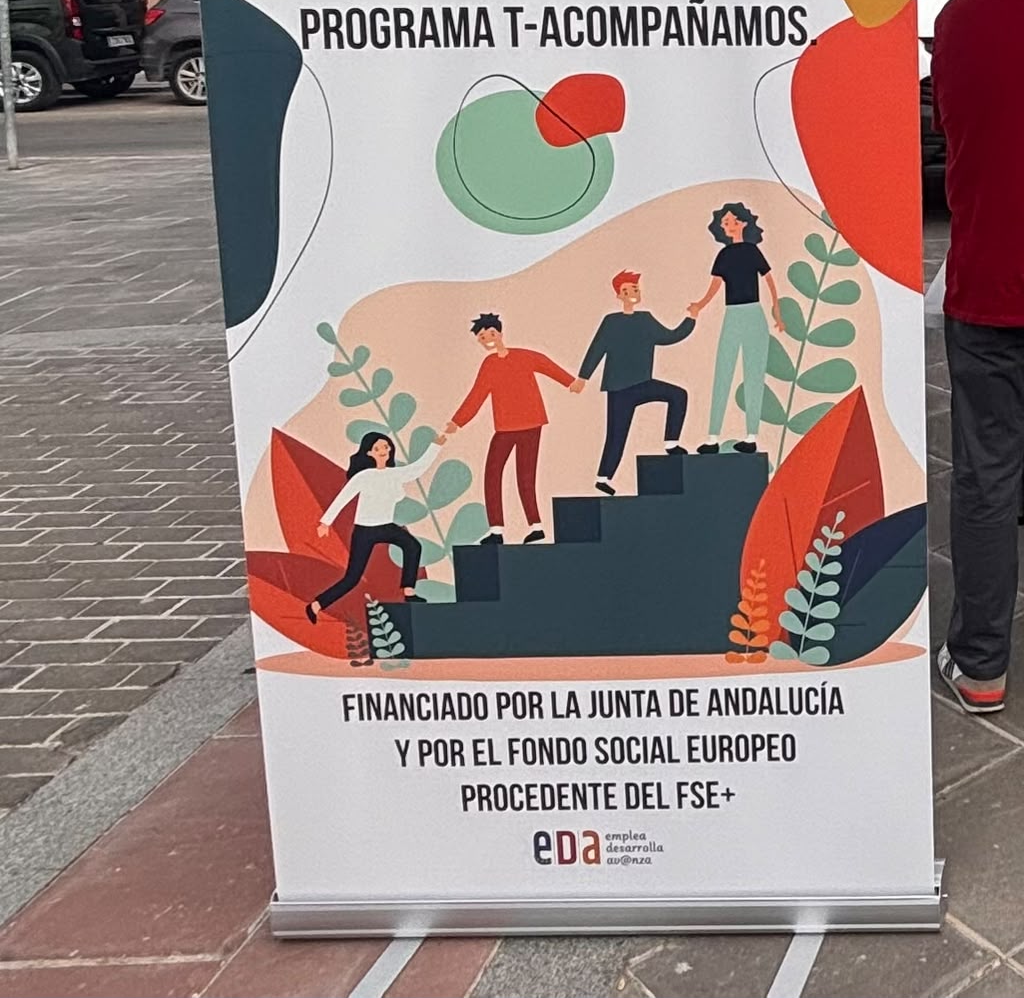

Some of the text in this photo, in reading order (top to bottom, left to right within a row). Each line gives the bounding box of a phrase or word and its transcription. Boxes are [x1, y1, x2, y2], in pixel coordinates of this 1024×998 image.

[300, 7, 492, 50] PROGRAMA
[342, 681, 845, 722] FINANCIADO POR LA JUNTA DE ANDALUCÍA
[394, 733, 797, 768] Y POR EL FONDO SOCIAL EUROPEO
[460, 781, 736, 812] PROCEDENTE DEL FSE+
[604, 829, 647, 843] emplea
[606, 840, 665, 853] desarrolla
[606, 854, 653, 866] av@nza
